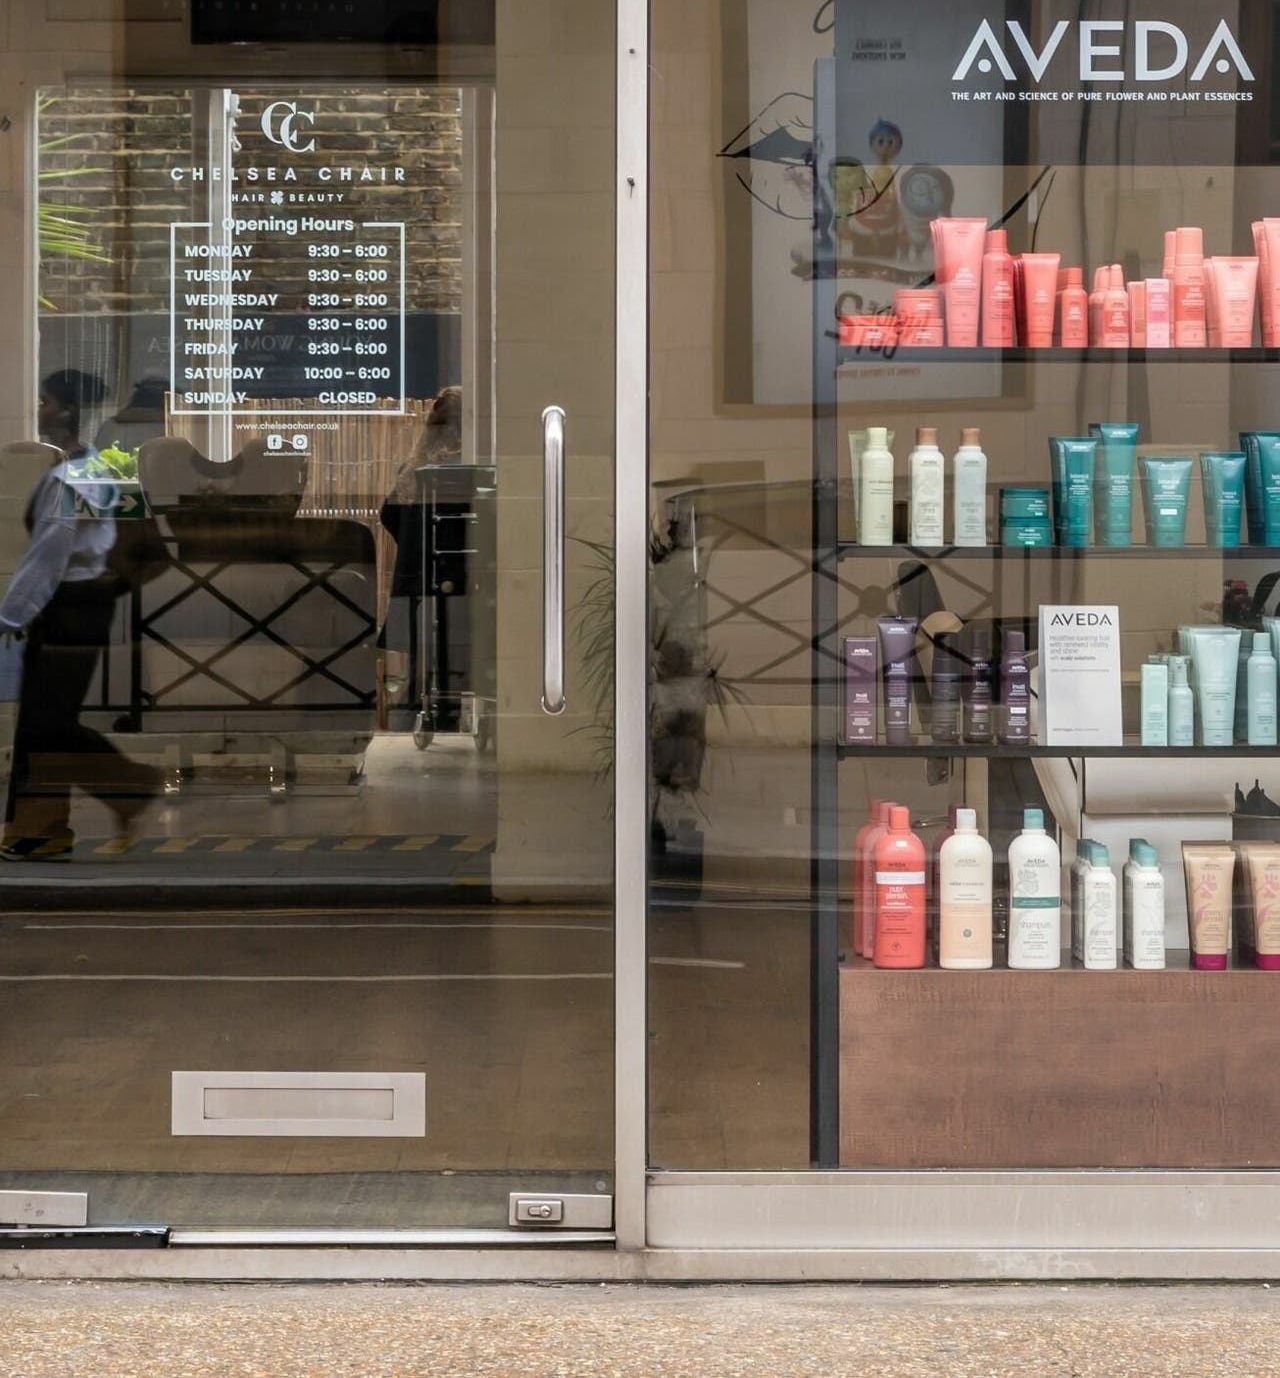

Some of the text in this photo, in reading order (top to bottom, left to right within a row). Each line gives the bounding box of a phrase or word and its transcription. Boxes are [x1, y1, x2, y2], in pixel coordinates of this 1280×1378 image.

[951, 18, 1256, 83] AVEDA
[952, 92, 969, 100] THE
[973, 92, 991, 100] ART
[995, 92, 1015, 100] AND
[1019, 92, 1058, 100] SCIENCE
[171, 167, 406, 181] CHELSEA CHAIR
[231, 193, 344, 202] HAIR BEAUTY
[222, 216, 354, 235] Opening Hours
[185, 245, 252, 257] MONDAY
[308, 245, 339, 257] 9:30
[355, 245, 387, 257] 6:00
[185, 270, 252, 282] TUESDAY
[308, 270, 339, 282] 9:30
[355, 270, 387, 282] 6:00
[185, 294, 278, 306] WEDNESDAY
[308, 294, 339, 306] 9:30
[355, 294, 387, 306] 6:00
[185, 319, 264, 331] THURSDAY
[308, 319, 339, 331] 9:30
[355, 319, 387, 331] 6:00
[185, 343, 238, 355] FRIDAY
[308, 343, 339, 355] 9:30
[355, 343, 387, 355] 6:00
[185, 368, 264, 380] SATURDAY
[305, 368, 342, 380] 10:00
[358, 368, 390, 380] 6:00
[185, 392, 376, 404] SUNDAY CLOSED
[1050, 613, 1112, 626] AVEDA
